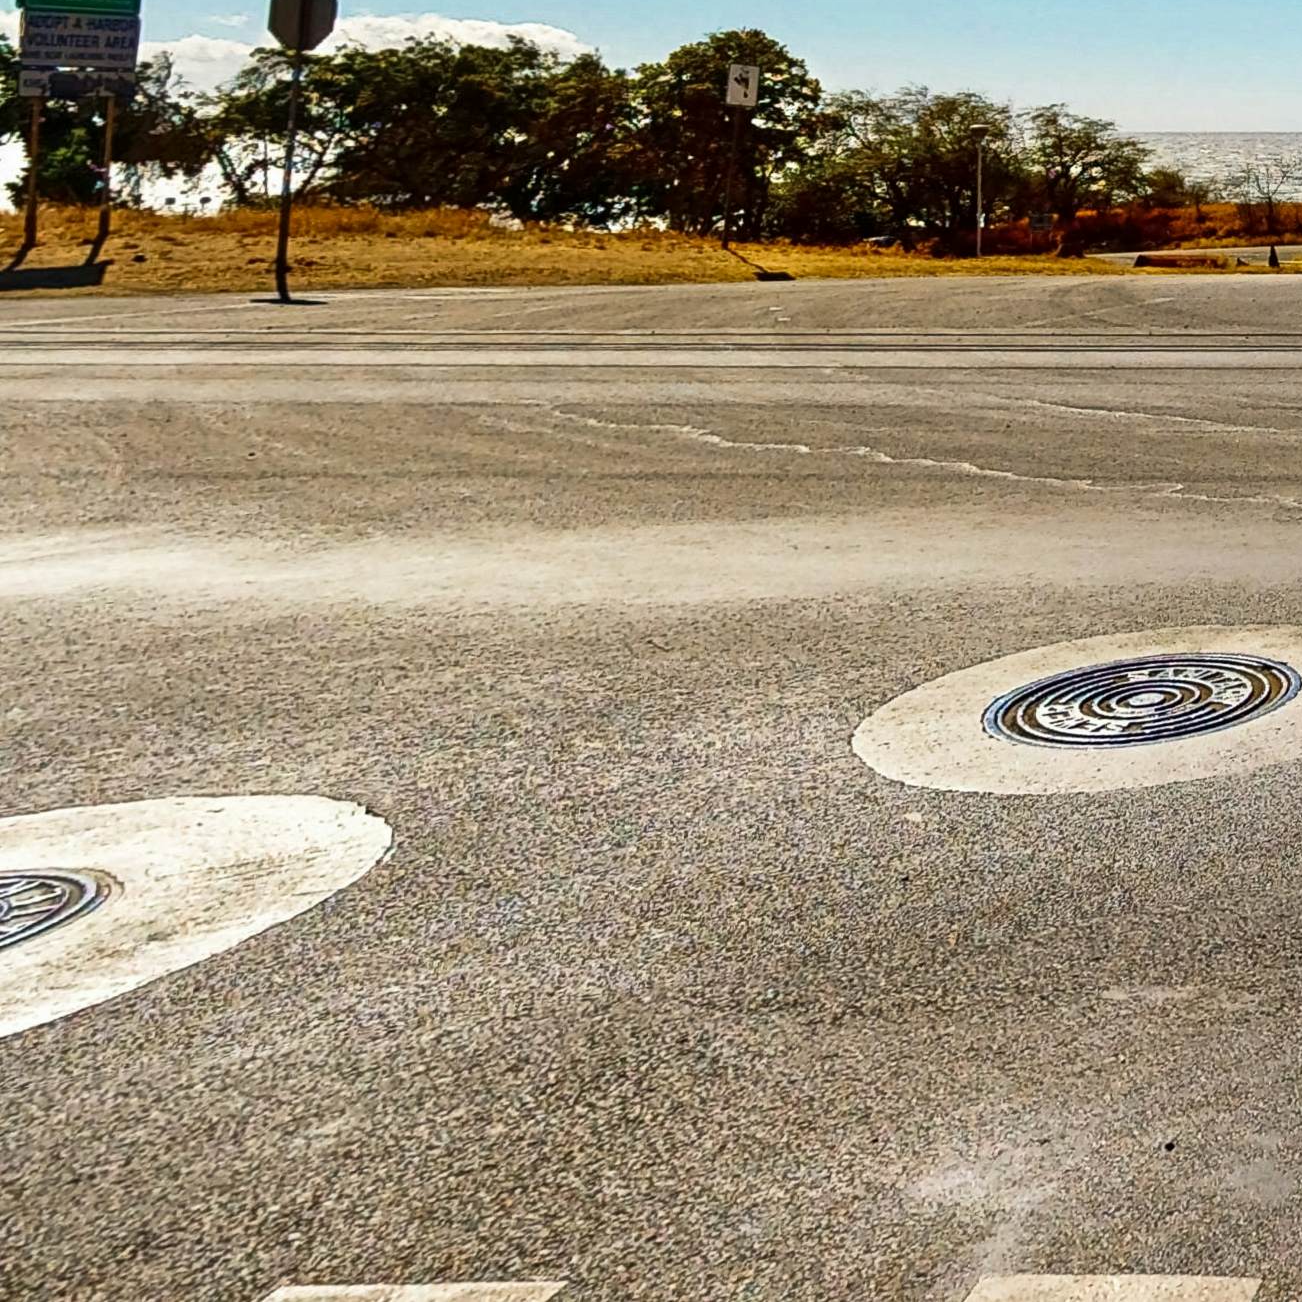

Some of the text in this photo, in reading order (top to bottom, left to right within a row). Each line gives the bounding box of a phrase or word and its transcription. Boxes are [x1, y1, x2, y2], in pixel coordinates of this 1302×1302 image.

[72, 17, 83, 29] A
[26, 33, 136, 50] VOLUNTEER AREA
